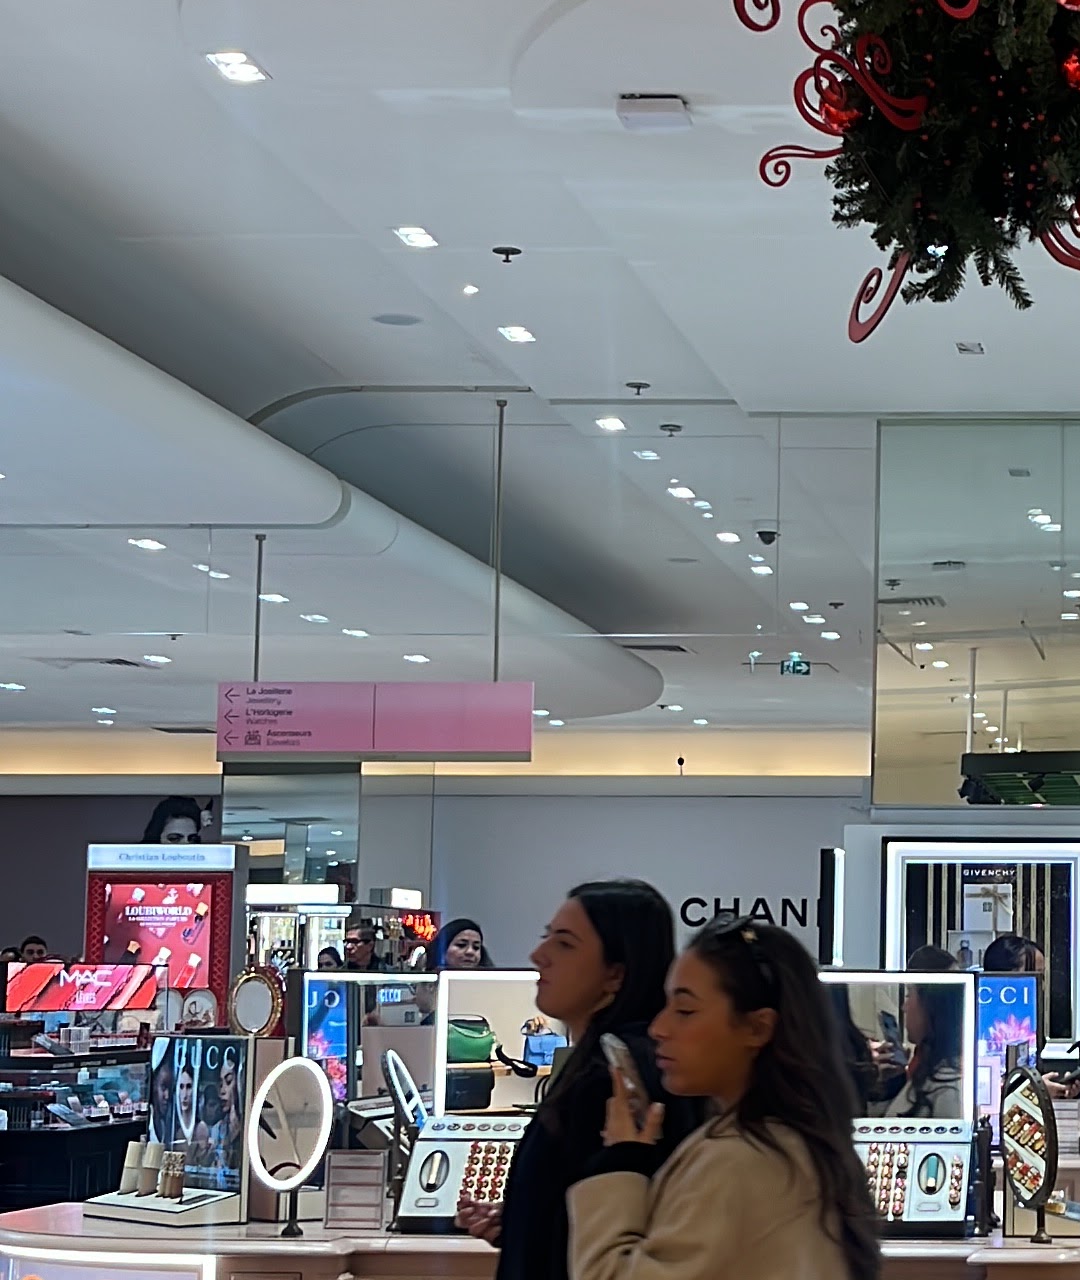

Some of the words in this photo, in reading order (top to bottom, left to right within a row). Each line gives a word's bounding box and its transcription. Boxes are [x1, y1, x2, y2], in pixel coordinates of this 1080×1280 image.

[119, 852, 159, 862] Christian
[161, 852, 206, 862] Louboutin
[125, 905, 193, 917] LOUBIWORLD
[59, 969, 113, 987] MAC
[978, 986, 1029, 1005] CCI
